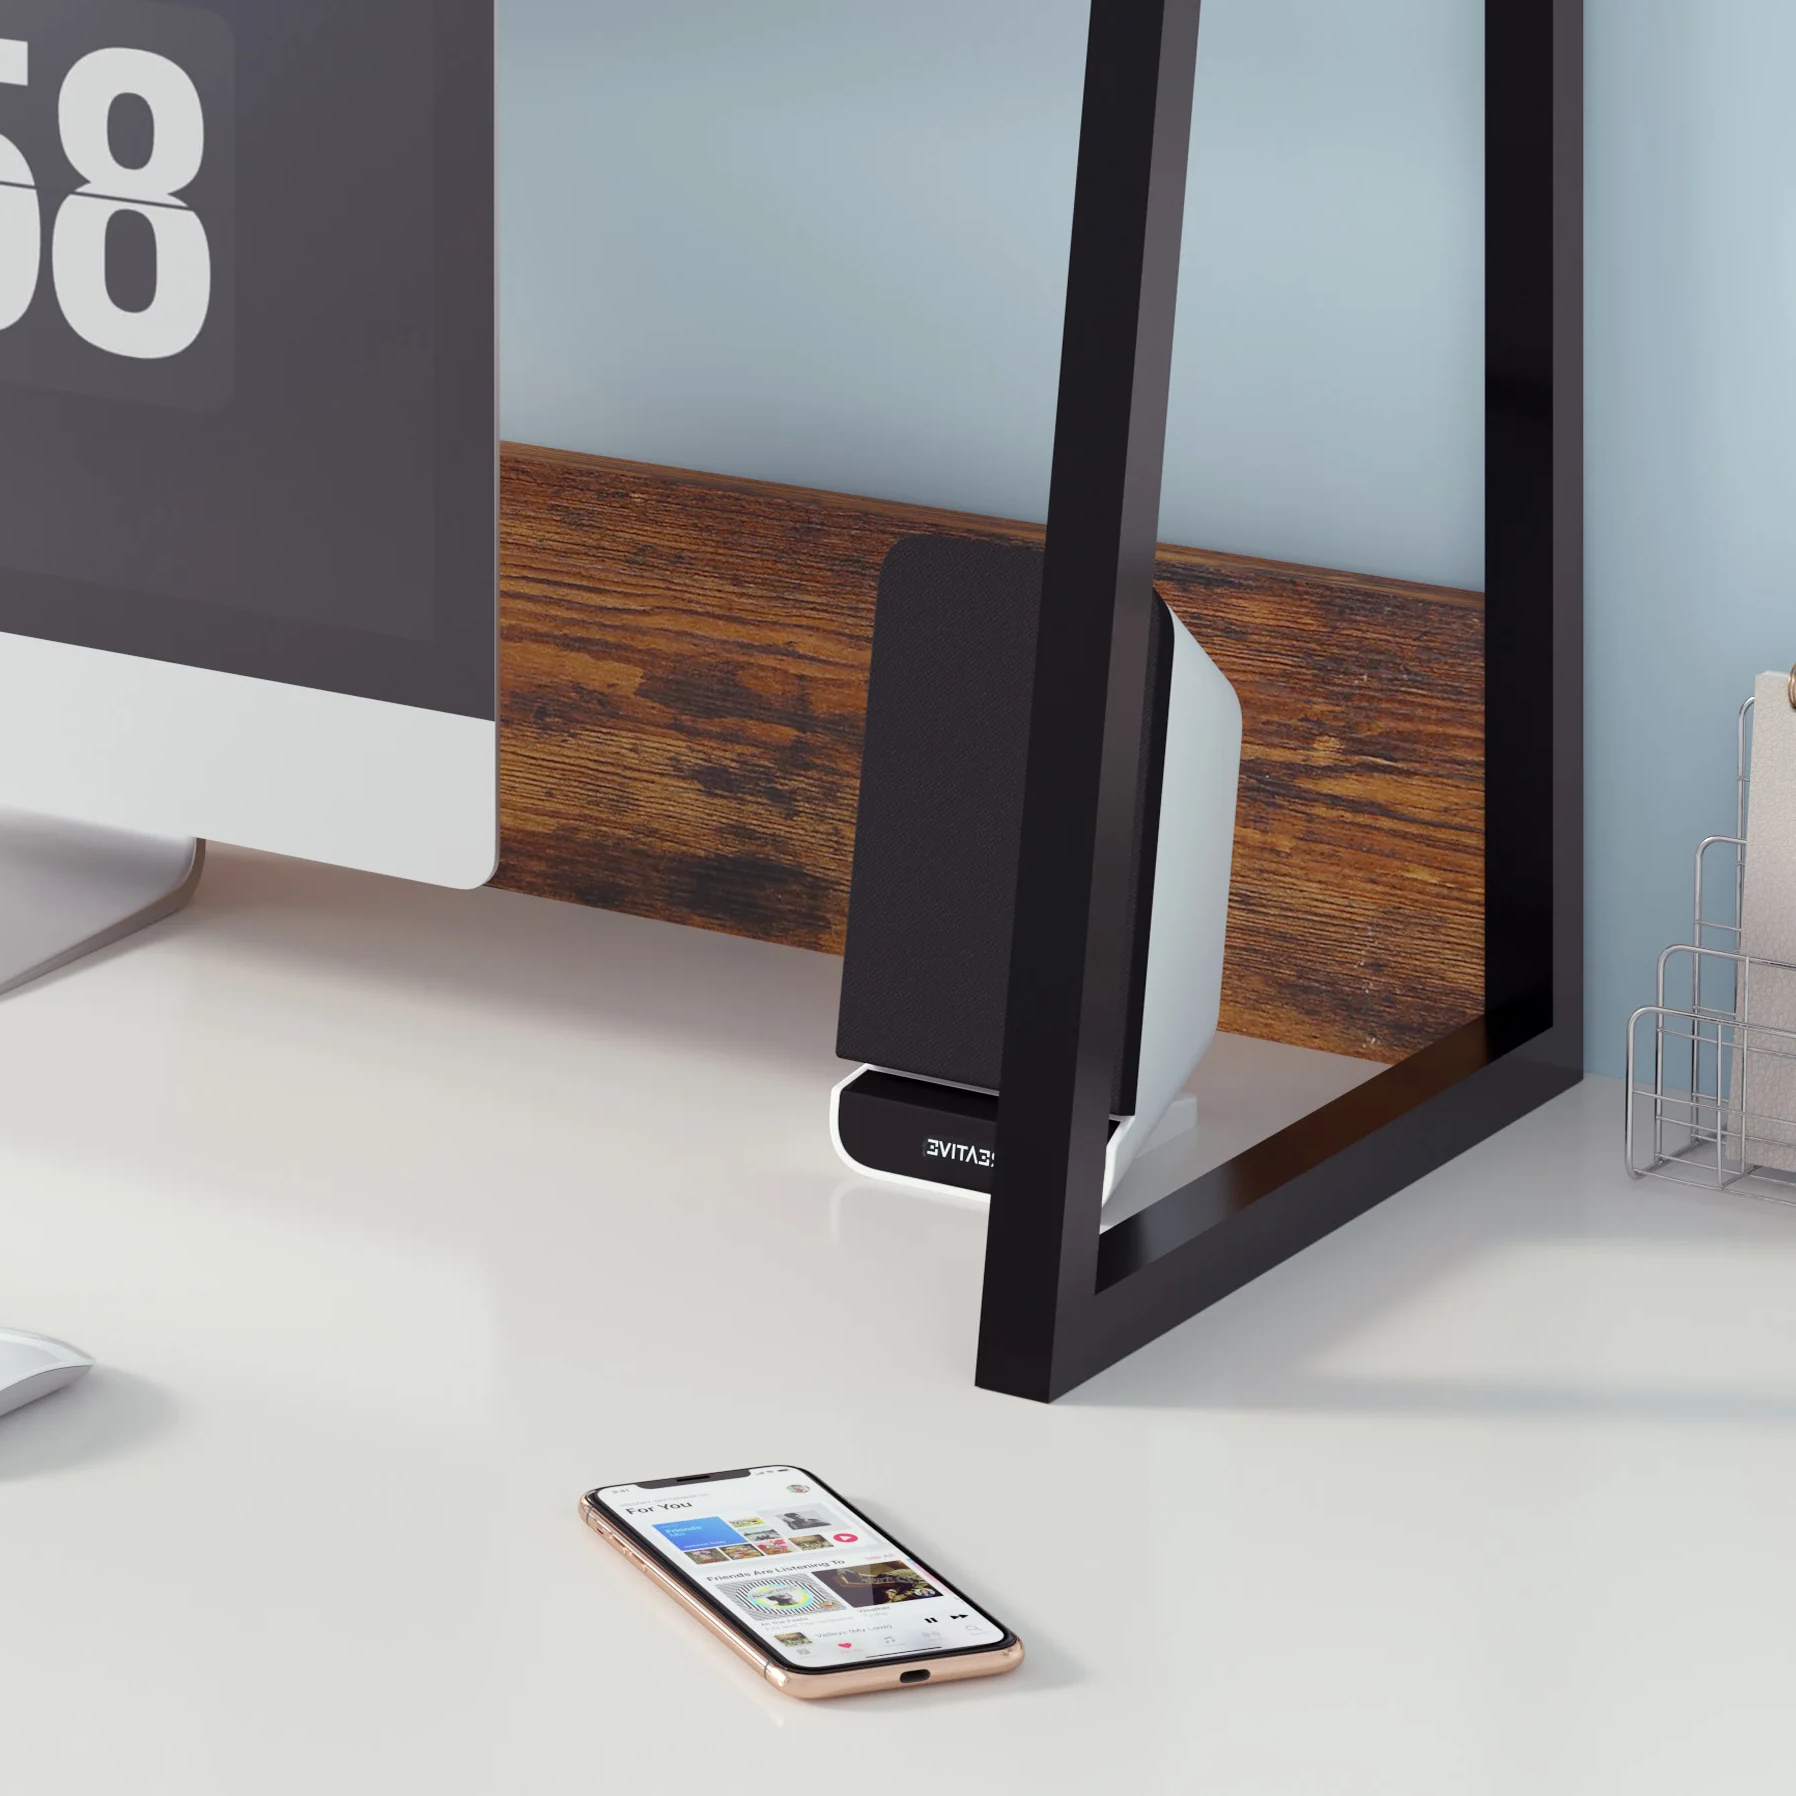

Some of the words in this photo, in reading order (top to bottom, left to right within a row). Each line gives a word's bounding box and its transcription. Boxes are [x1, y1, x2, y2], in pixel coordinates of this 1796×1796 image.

[625, 1506, 655, 1515] For
[657, 1502, 693, 1511] You
[706, 1571, 752, 1583] Friends
[753, 1567, 773, 1576] Are
[775, 1559, 828, 1573] Listening
[829, 1558, 845, 1566] To
